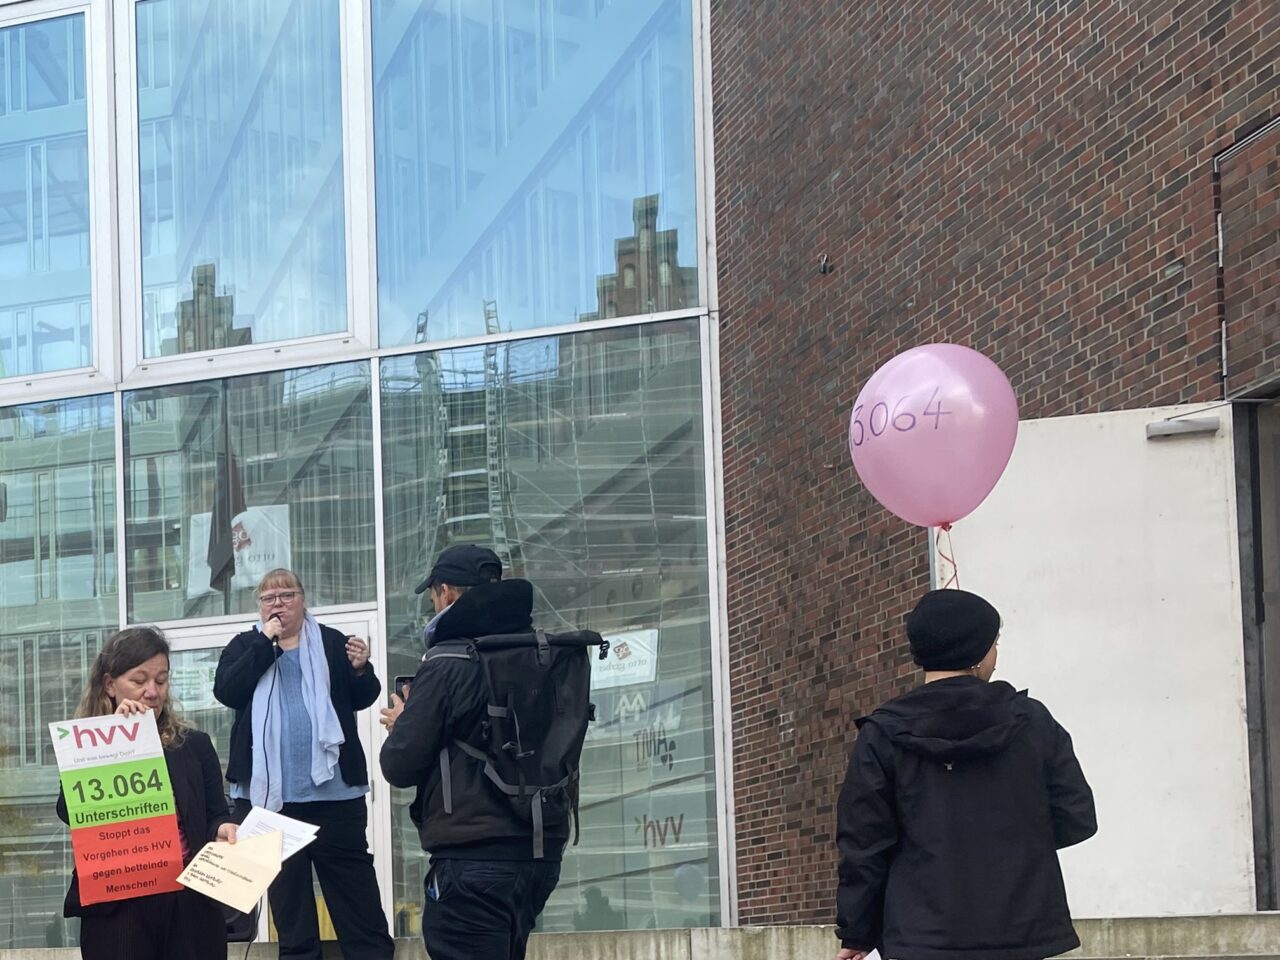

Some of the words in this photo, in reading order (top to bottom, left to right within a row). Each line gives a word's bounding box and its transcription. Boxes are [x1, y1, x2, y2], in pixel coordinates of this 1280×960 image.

[72, 768, 163, 804] 13.064
[75, 801, 169, 825] Unterschriften
[98, 829, 131, 841] Stoppt
[133, 826, 151, 835] das
[83, 848, 130, 861] Vorgehen
[131, 845, 150, 854] des
[151, 840, 172, 851] HVV
[92, 867, 122, 880] gegen
[106, 878, 158, 894] Menschen!
